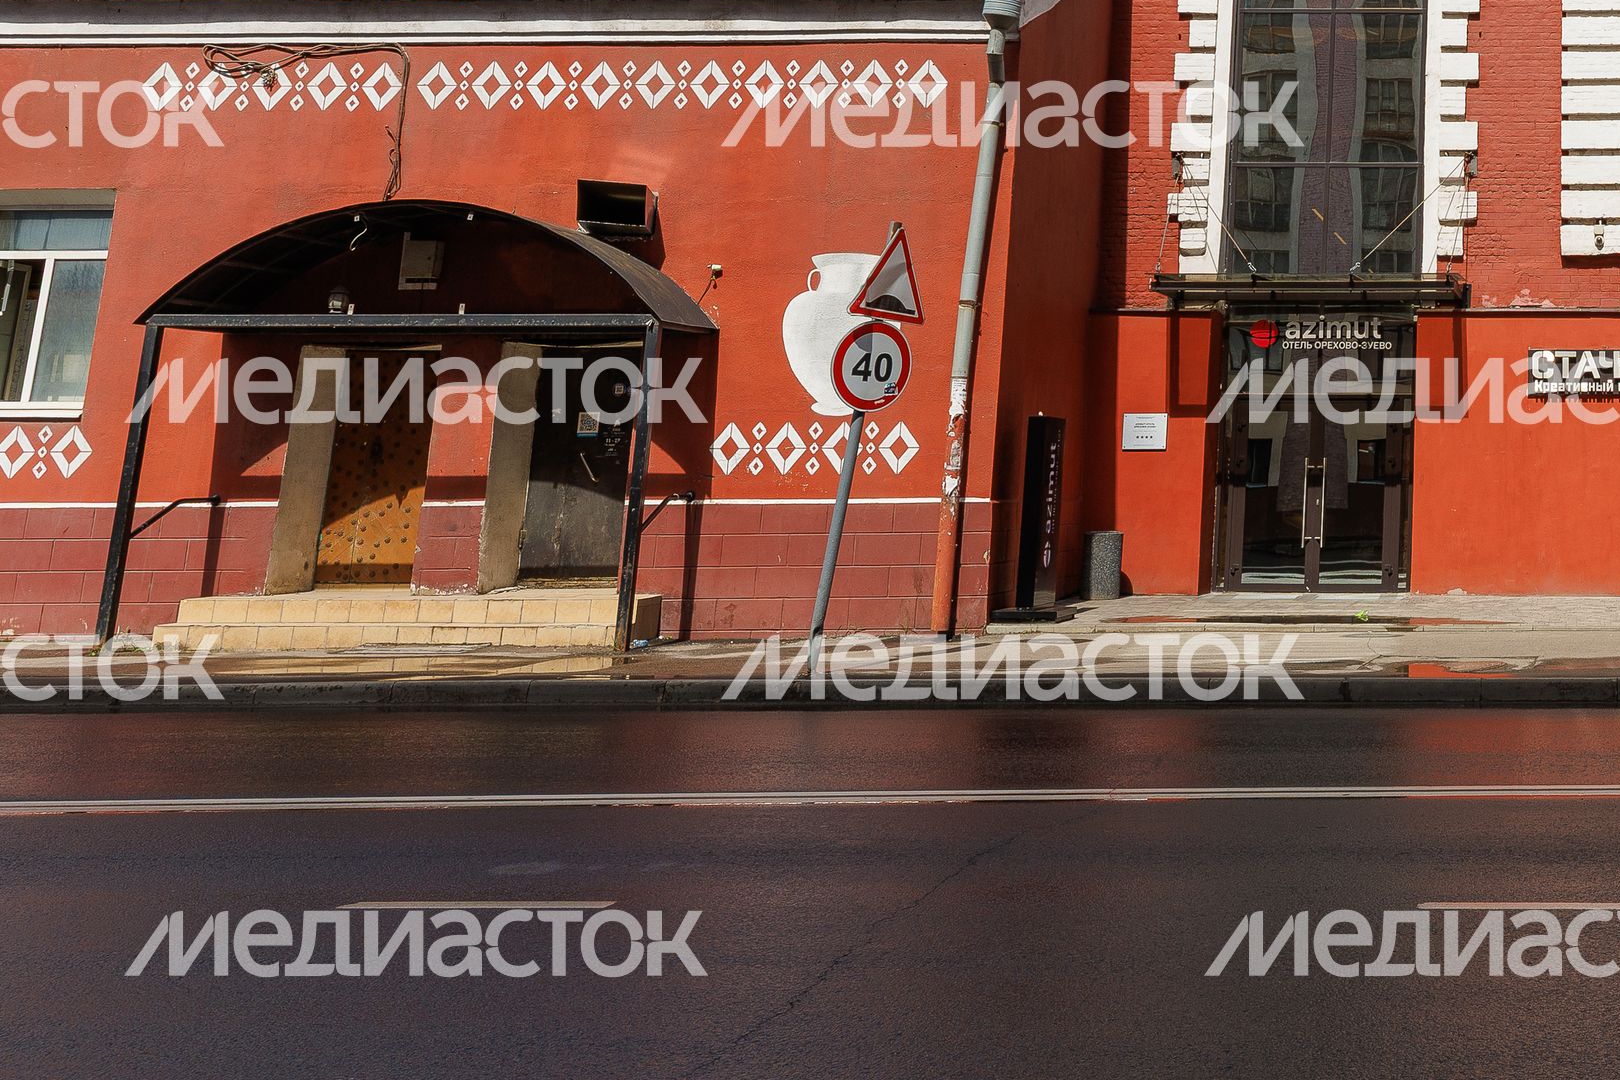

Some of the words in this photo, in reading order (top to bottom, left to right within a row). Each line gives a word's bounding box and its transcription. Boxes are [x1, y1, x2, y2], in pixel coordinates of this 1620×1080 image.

[1285, 315, 1382, 340] azimut
[1281, 340, 1313, 350] ОТЕЛЬ
[1313, 341, 1393, 350] ОРЕХОВО-ЗУЕВО
[851, 352, 893, 383] 40
[1534, 379, 1614, 392] Креативный
